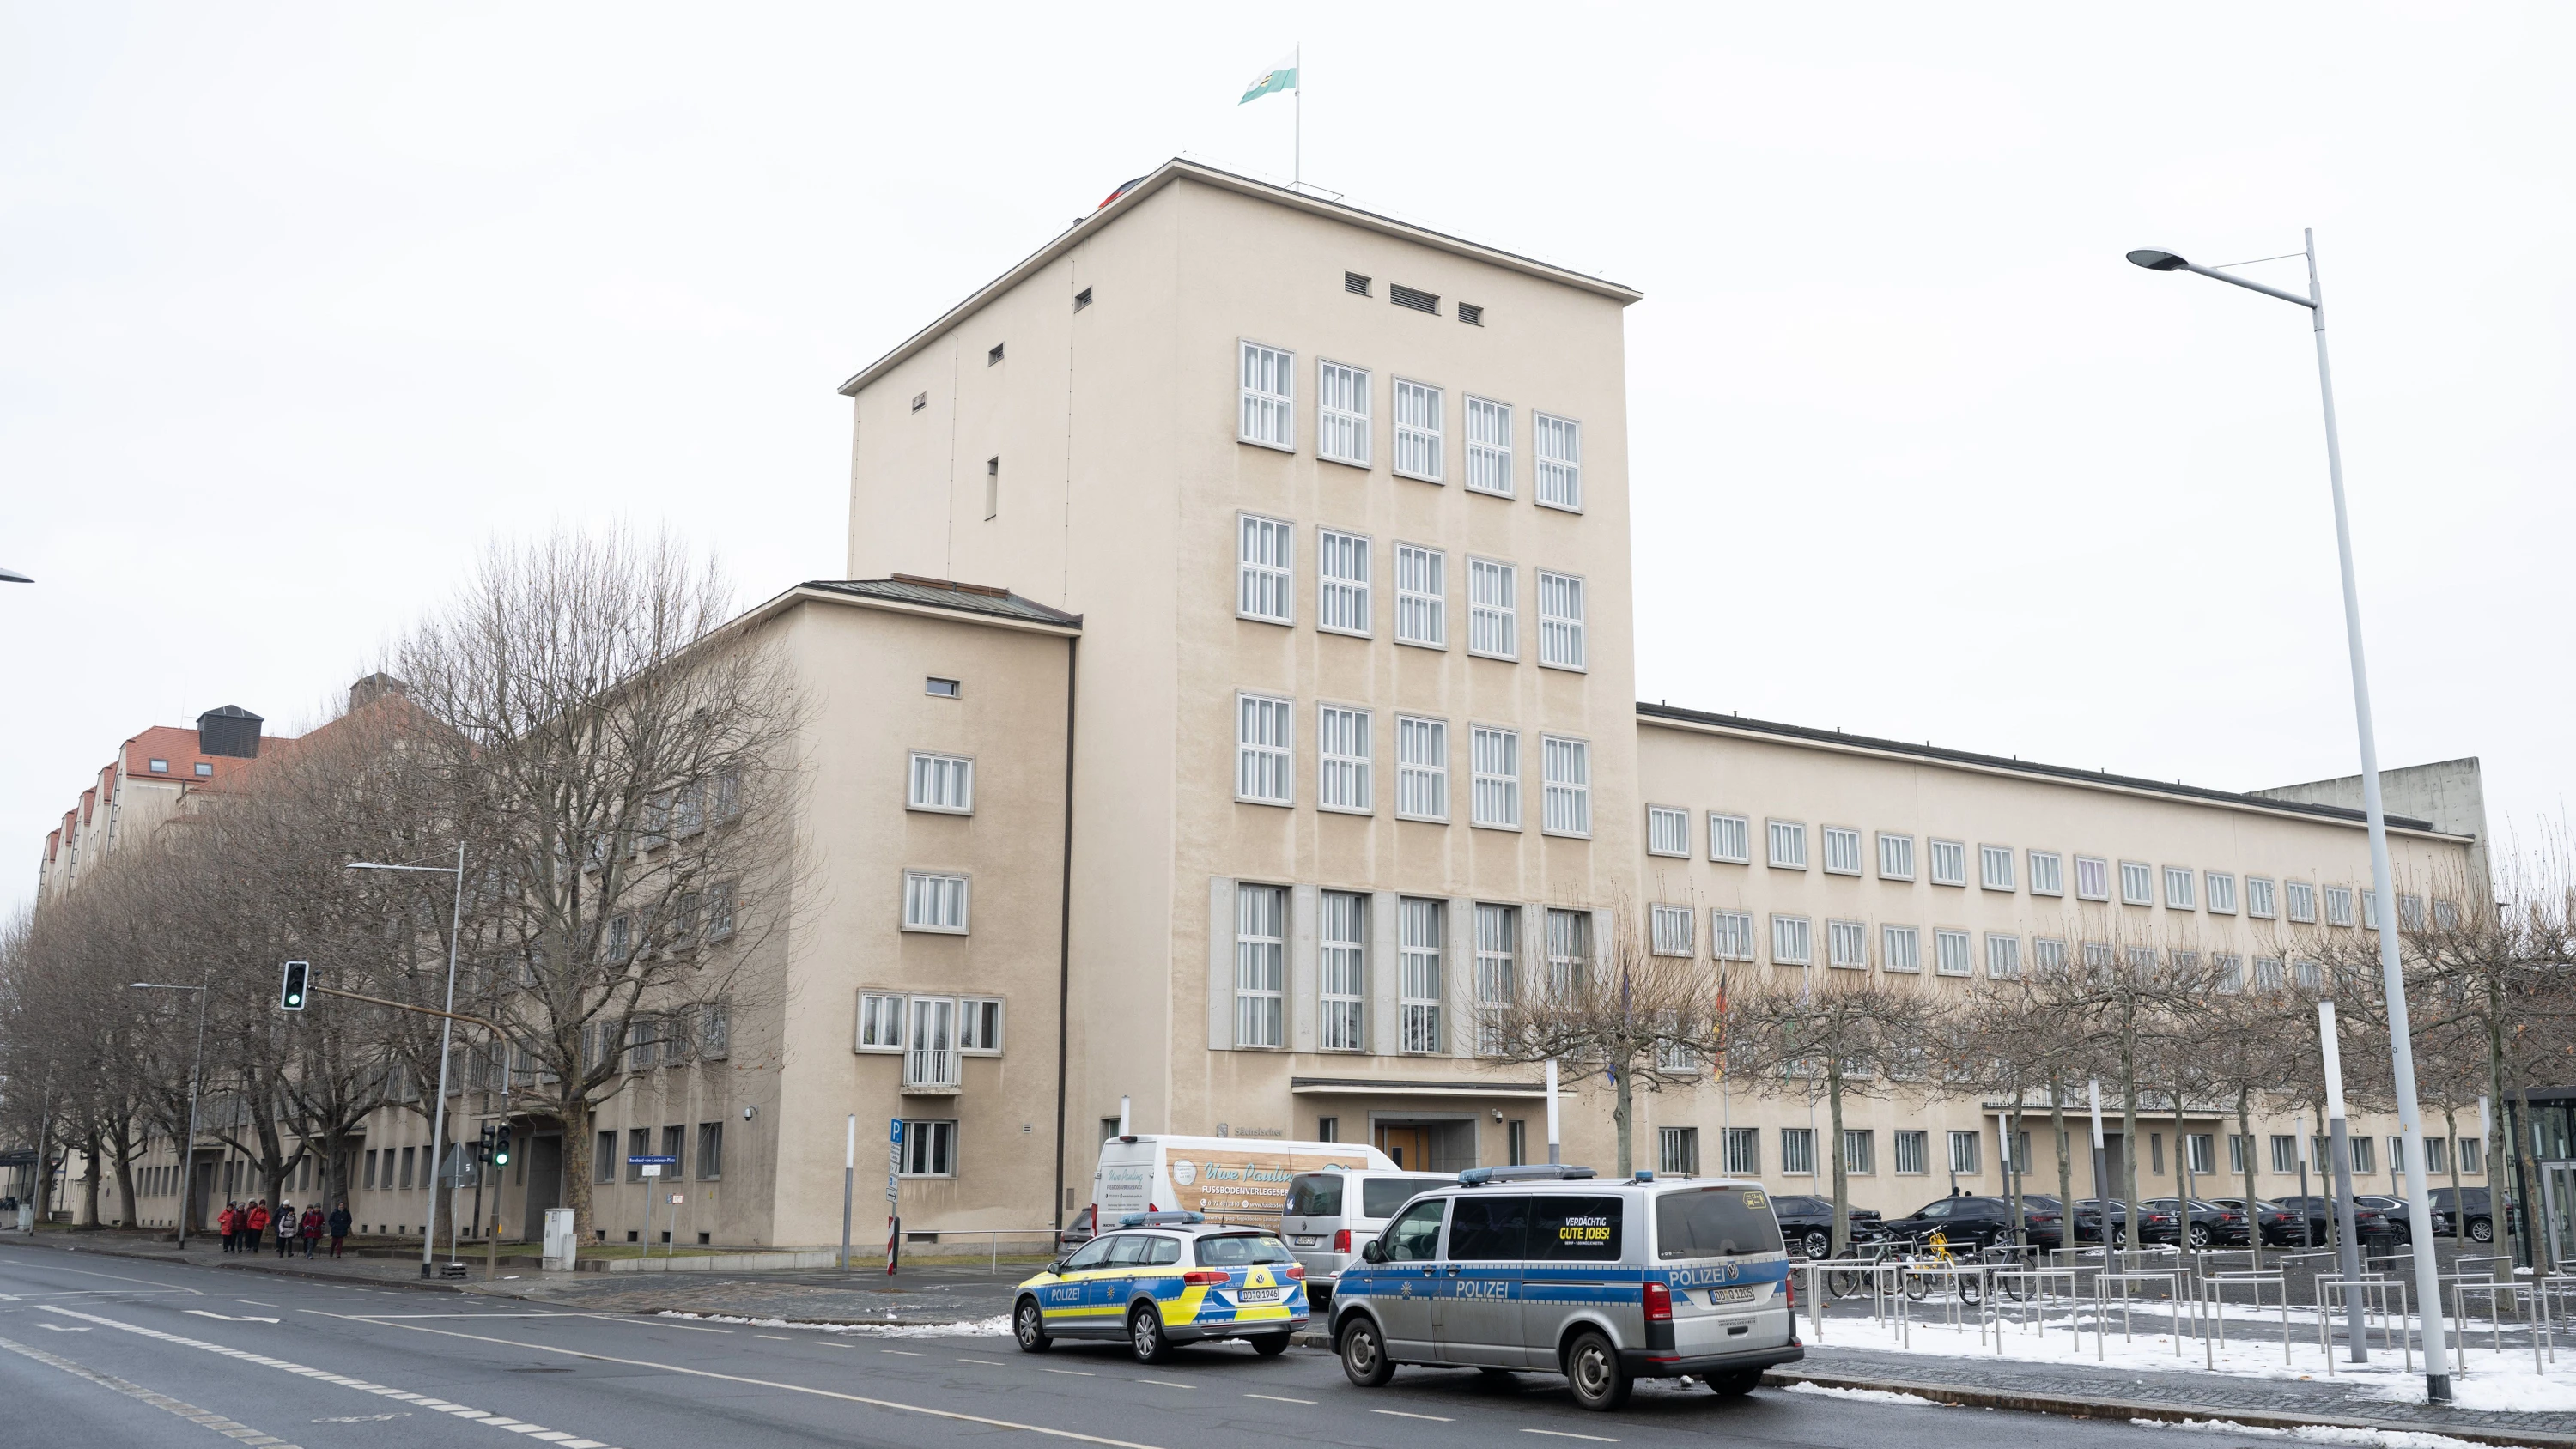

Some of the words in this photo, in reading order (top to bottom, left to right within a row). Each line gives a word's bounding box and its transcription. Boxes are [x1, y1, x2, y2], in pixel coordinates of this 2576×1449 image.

[893, 1122, 900, 1140] P
[1235, 1126, 1283, 1137] Sächsischer
[1204, 1161, 1240, 1180] Uwe
[1565, 1216, 1607, 1226] VERDÄCHTIG
[1559, 1227, 1584, 1240] GUTE
[1585, 1227, 1610, 1240] JOBS!
[1669, 1269, 1725, 1286] POLIZEI
[1051, 1288, 1080, 1302] POLIZEI
[1243, 1291, 1253, 1300] DD
[1456, 1280, 1509, 1299] POLIZEI
[1715, 1291, 1726, 1300] DD
[1728, 1290, 1735, 1299] Q
[1735, 1288, 1753, 1299] 1205
